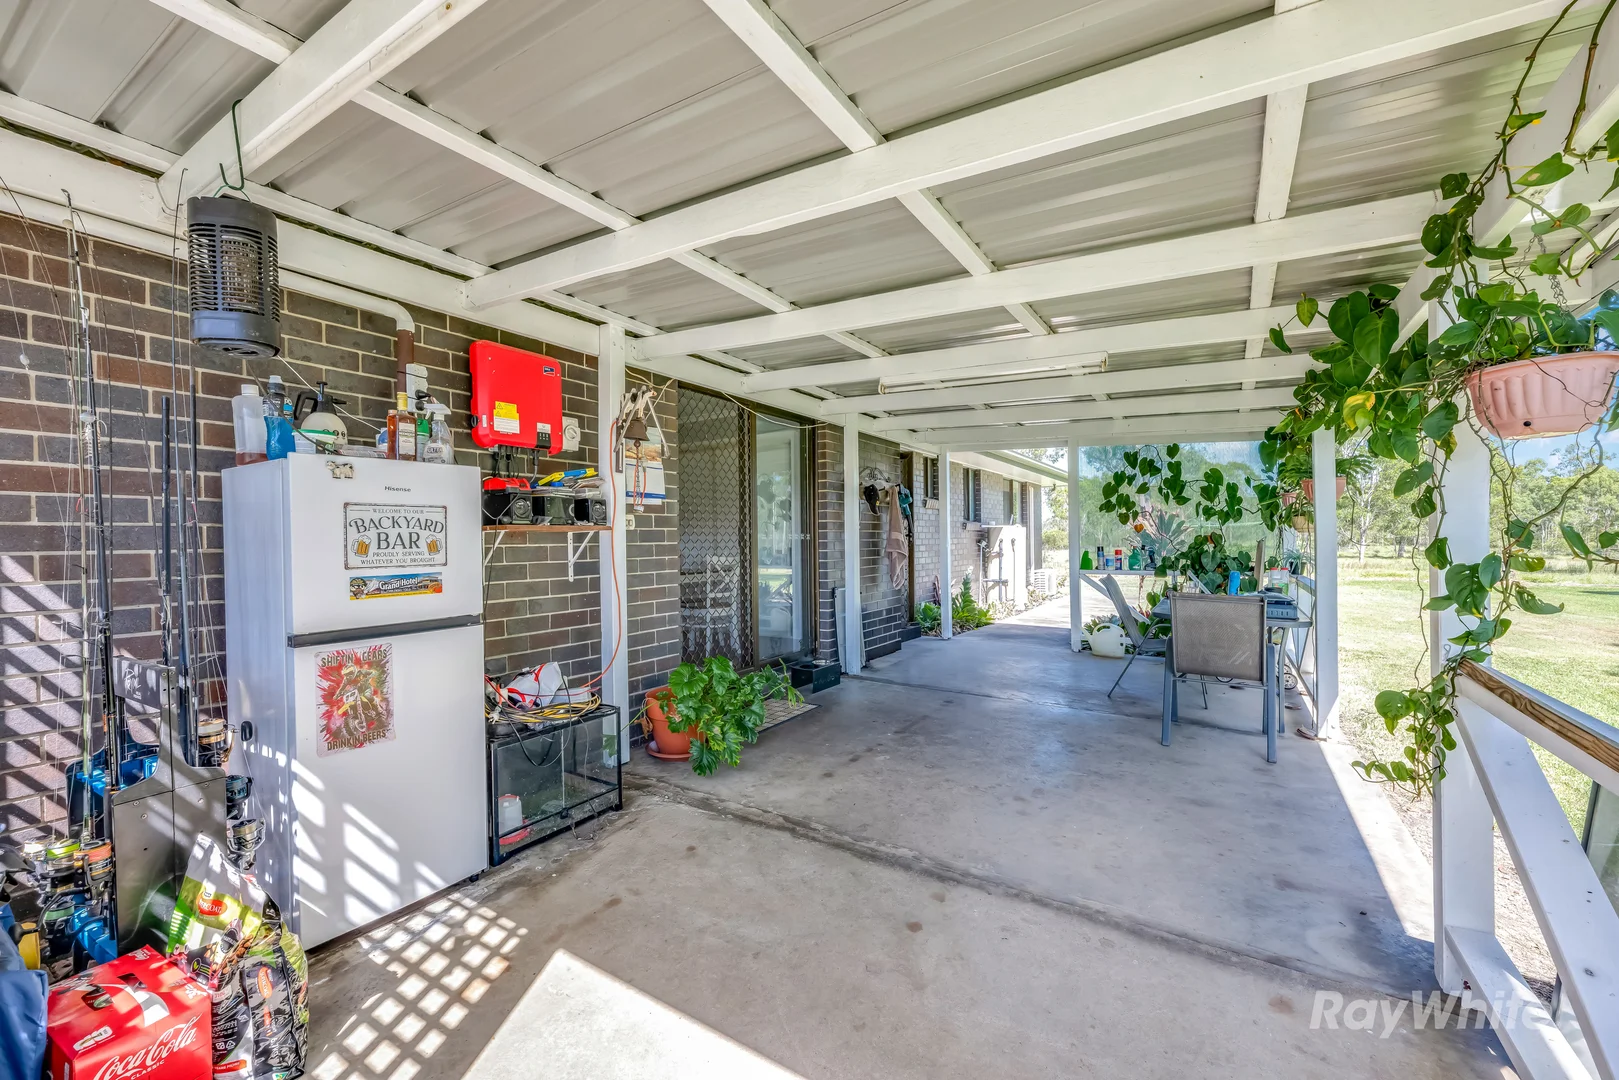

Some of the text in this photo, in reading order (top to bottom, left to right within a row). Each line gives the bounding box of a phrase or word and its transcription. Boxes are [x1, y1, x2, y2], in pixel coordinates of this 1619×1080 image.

[348, 515, 444, 534] BACKYARD
[376, 531, 421, 550] BAR
[379, 579, 400, 590] Grand
[362, 649, 388, 662] GEARS
[363, 729, 387, 744] BEERS
[93, 1013, 202, 1080] Coca-Cola
[131, 1060, 165, 1080] CLASSIC
